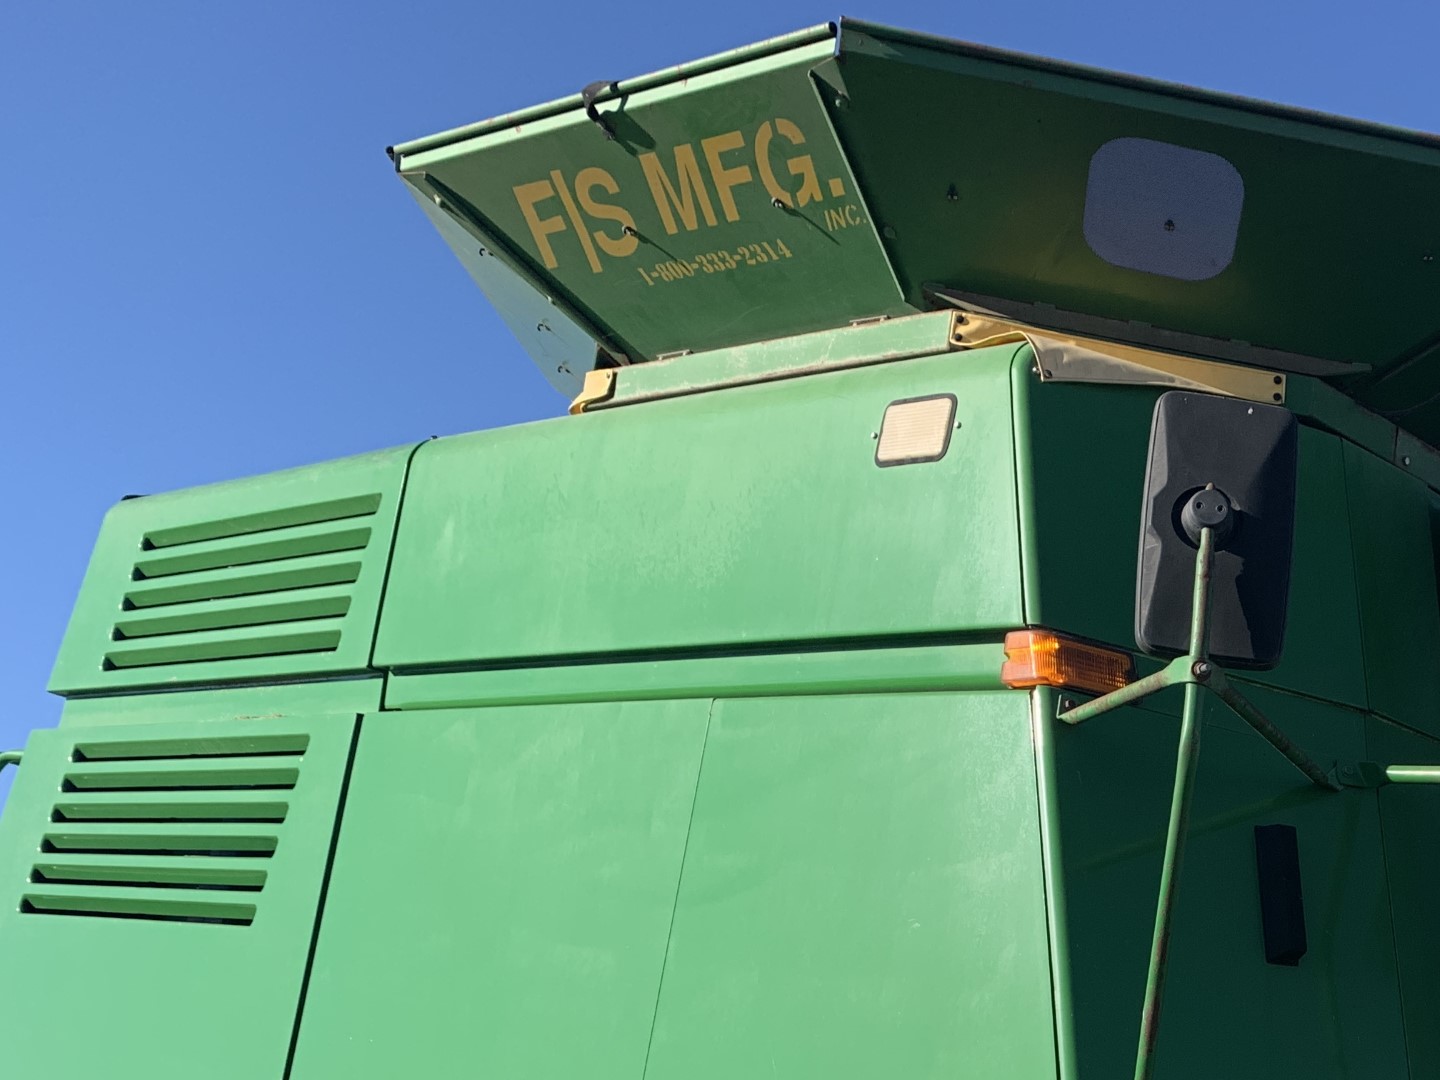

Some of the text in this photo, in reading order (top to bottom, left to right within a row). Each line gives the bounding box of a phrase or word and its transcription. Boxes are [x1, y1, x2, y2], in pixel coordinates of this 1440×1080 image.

[638, 117, 846, 236] MFG.
[823, 204, 868, 232] INC.
[637, 238, 793, 286] 1-800-333-2314
